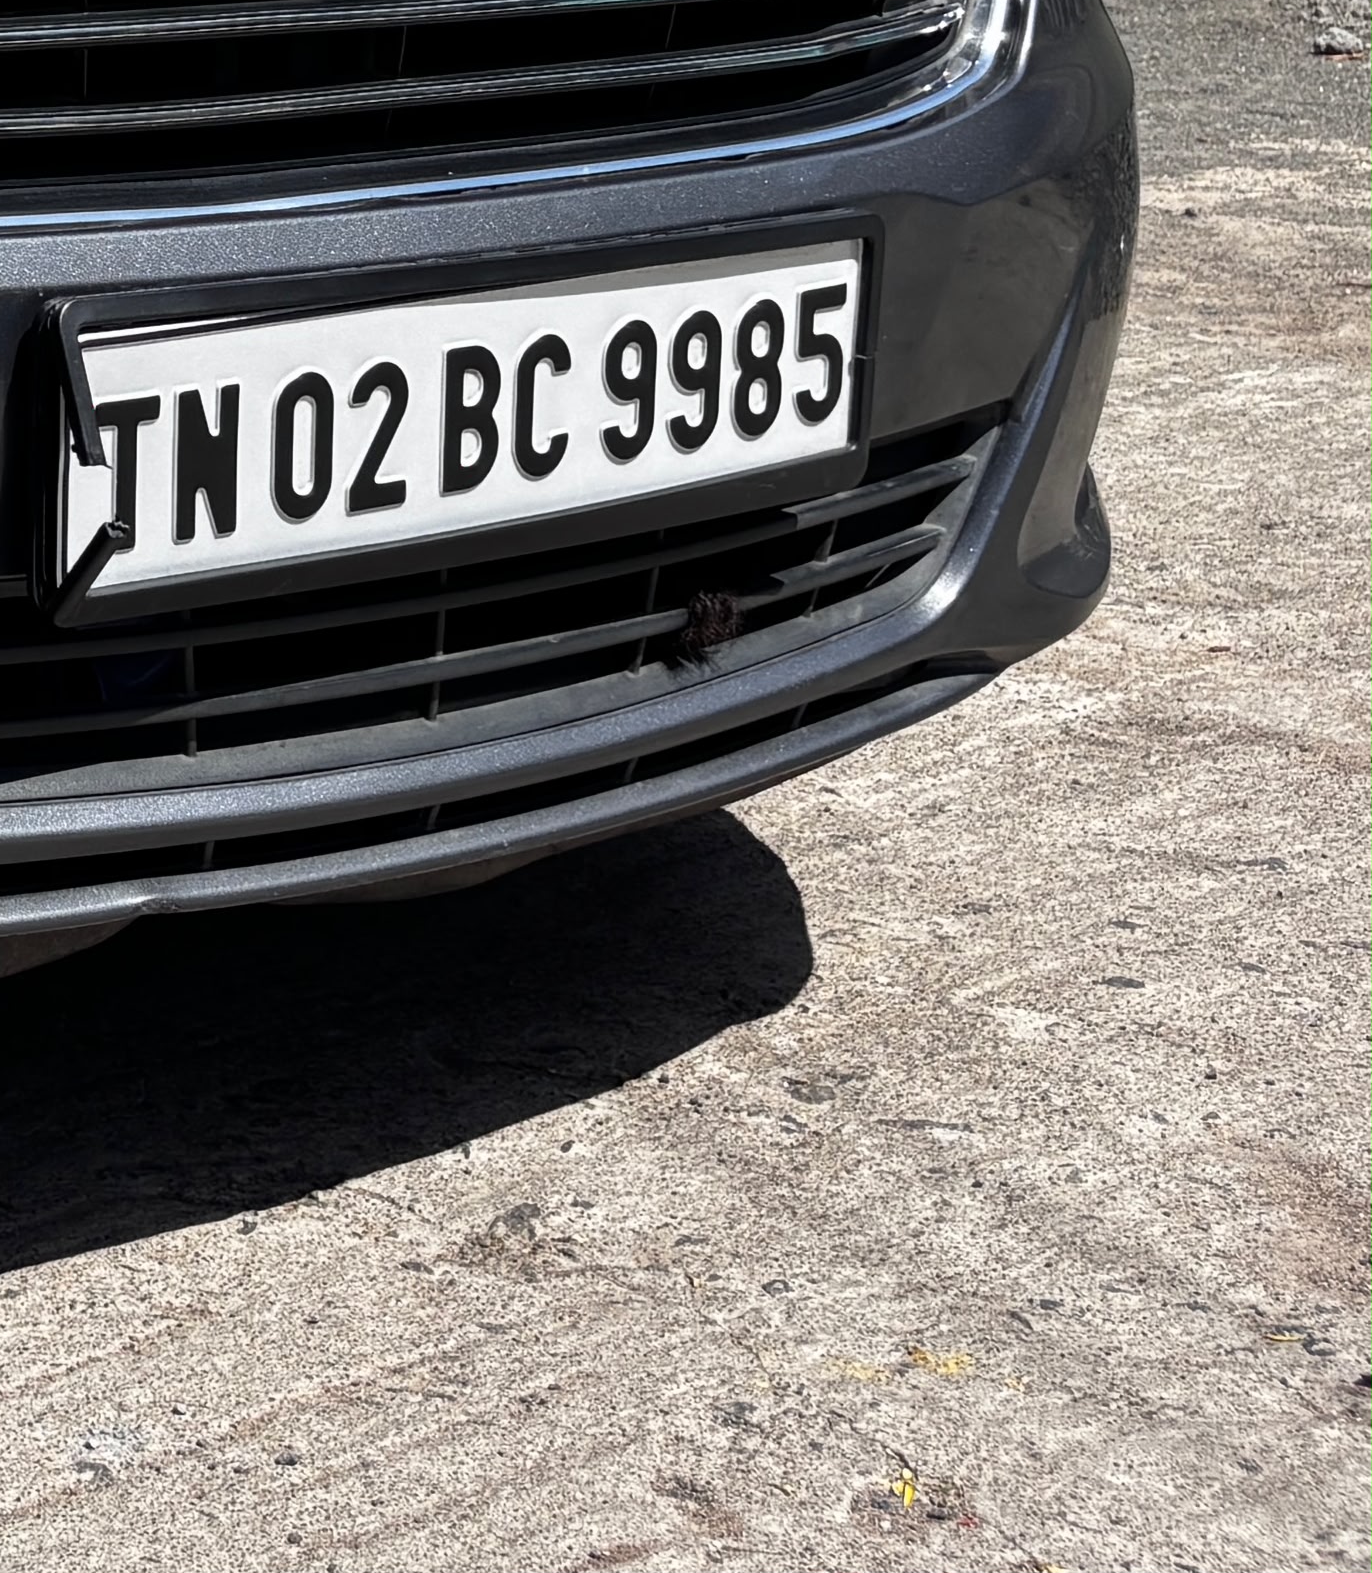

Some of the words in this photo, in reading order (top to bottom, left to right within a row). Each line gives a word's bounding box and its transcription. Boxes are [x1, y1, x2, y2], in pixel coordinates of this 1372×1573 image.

[95, 383, 239, 550] TN
[274, 360, 409, 522] 02
[441, 332, 572, 496] BC
[602, 283, 848, 462] 9985
